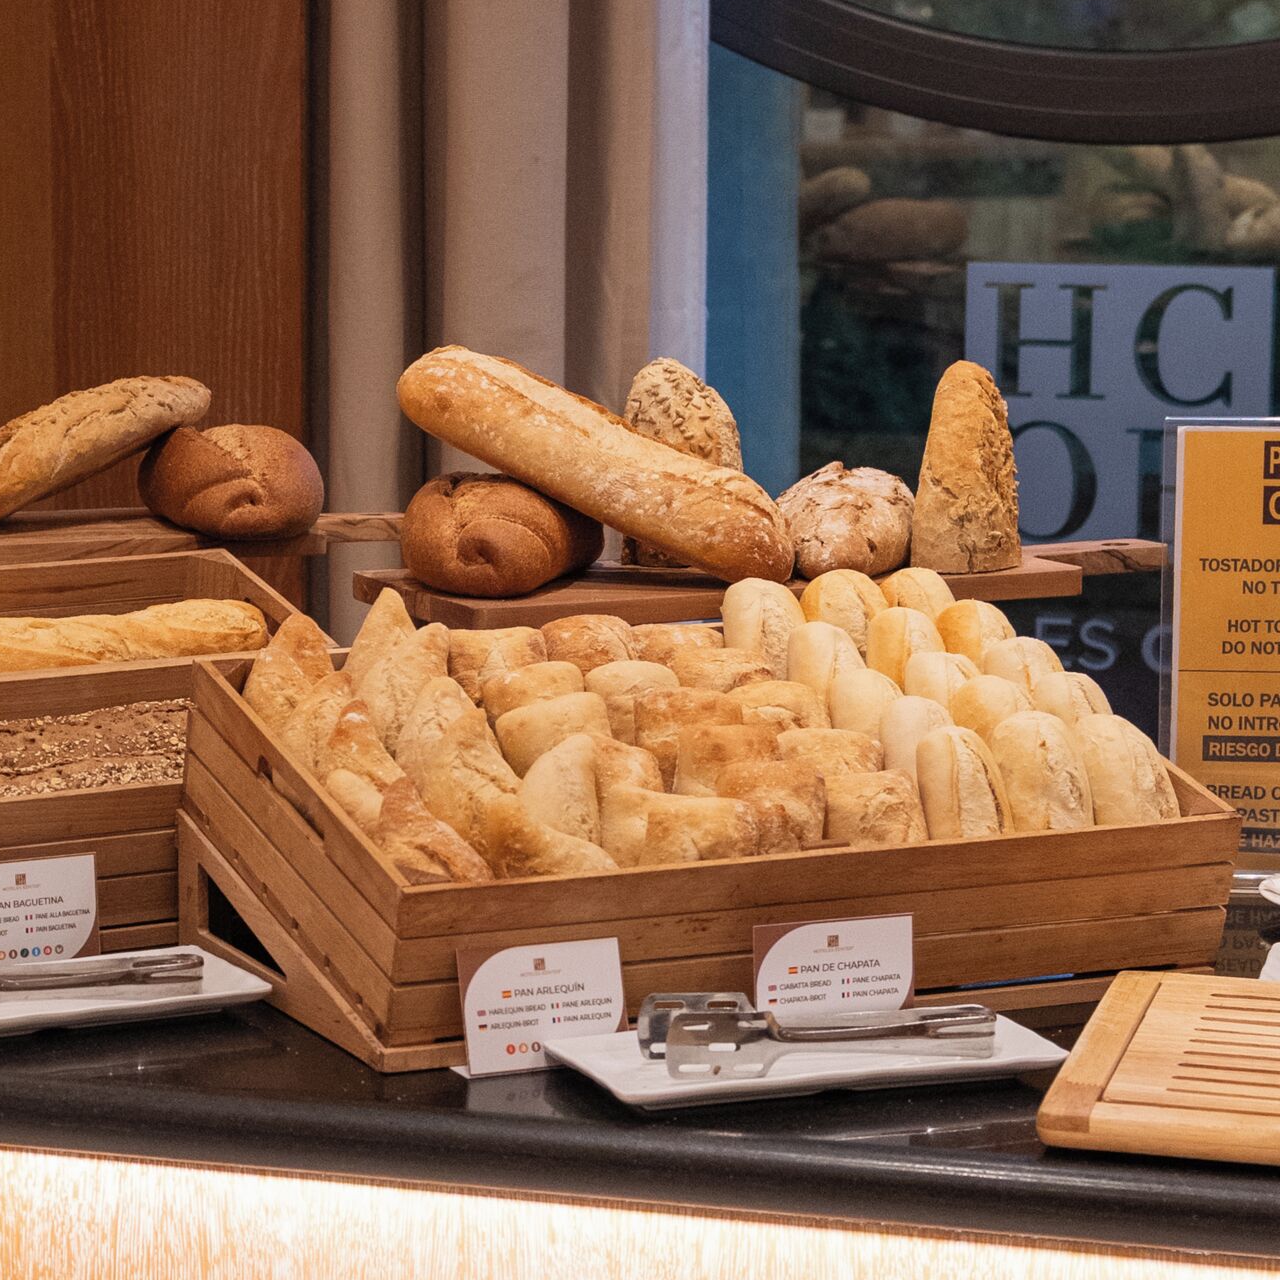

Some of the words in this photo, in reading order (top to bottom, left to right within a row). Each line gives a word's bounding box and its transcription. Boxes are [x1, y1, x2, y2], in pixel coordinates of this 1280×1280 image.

[984, 282, 1234, 408] HC
[1242, 580, 1266, 595] NO
[1227, 619, 1261, 634] HOT
[1222, 641, 1246, 655] DO
[1208, 692, 1255, 708] SOLO
[1208, 715, 1233, 731] NO
[1238, 715, 1280, 732] INTR
[1209, 741, 1271, 758] RIESGO
[1206, 784, 1266, 800] BREAD
[13, 896, 64, 909] BAGUETINA
[35, 912, 49, 920] PANE
[62, 908, 90, 917] BAGUETINA
[48, 923, 77, 932] BAGUETINA
[801, 965, 819, 974] PAN
[822, 963, 835, 972] DE
[837, 959, 880, 971] CHAPATA
[780, 981, 808, 991] CIABATTA
[810, 980, 831, 989] BREAD
[852, 976, 869, 984] PANE
[871, 974, 901, 983] CHAPATA
[514, 988, 534, 997] PAN
[536, 982, 585, 995] ARLEQUÍN
[853, 990, 868, 998] PAIN
[869, 987, 899, 997] CHAPATA
[489, 1006, 524, 1016] HARLEQUIN
[525, 1004, 546, 1012] BREAD
